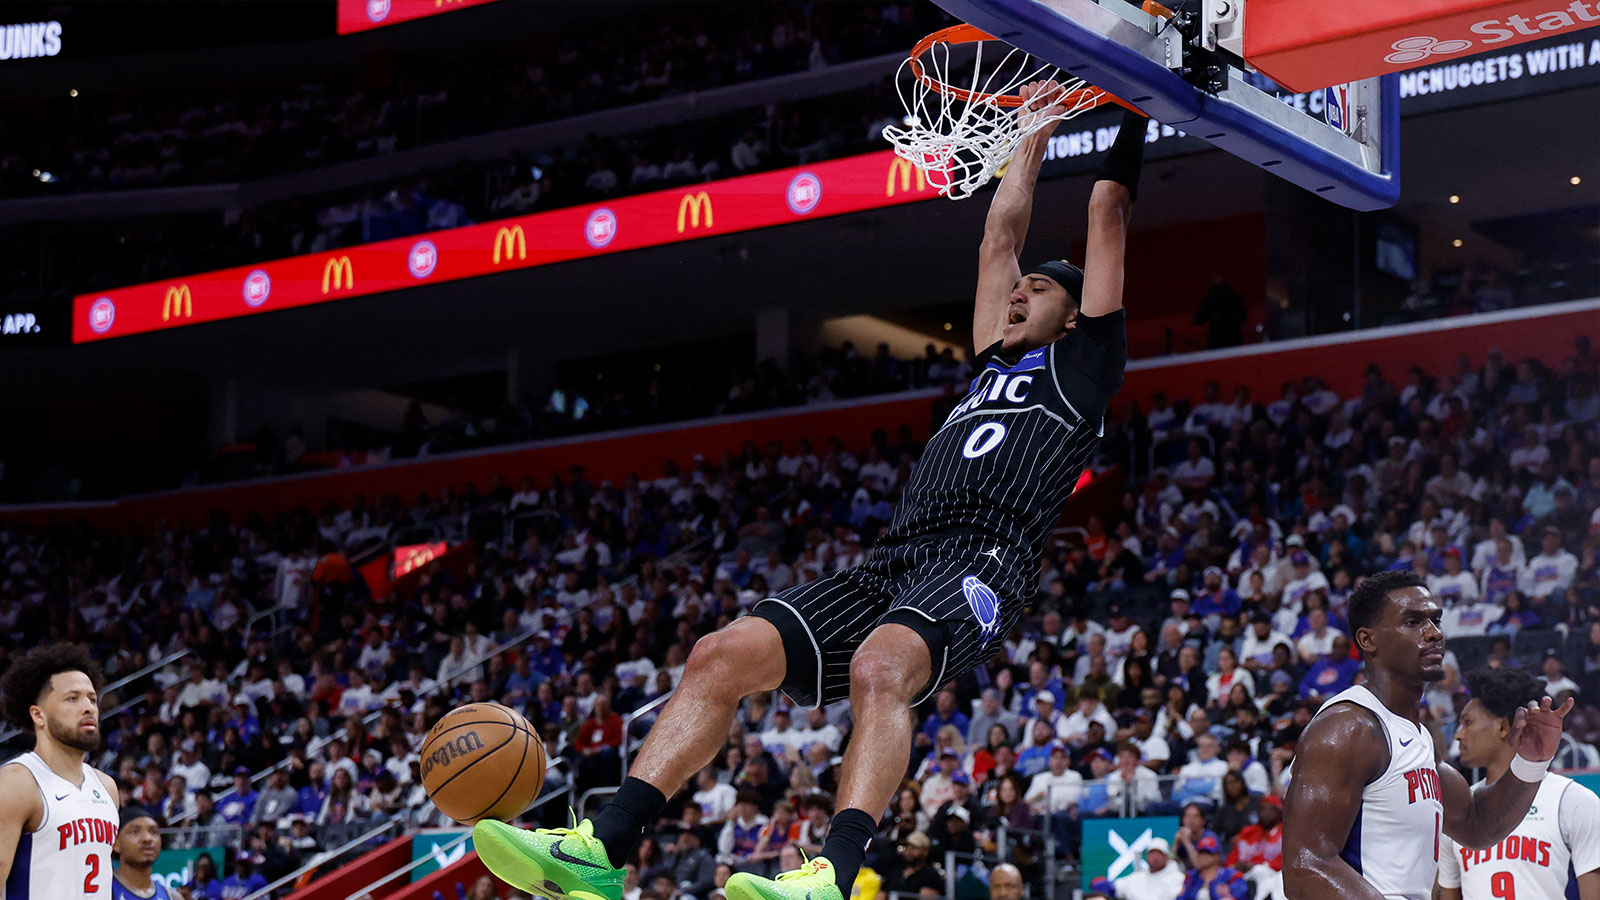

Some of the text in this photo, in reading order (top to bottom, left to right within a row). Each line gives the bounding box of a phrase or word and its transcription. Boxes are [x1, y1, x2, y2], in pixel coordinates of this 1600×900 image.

[1400, 53, 1524, 99] MCNUGGETS
[1525, 42, 1585, 76] WITH
[1042, 130, 1094, 161] TONS
[2, 312, 40, 335] APP.
[963, 421, 1007, 459] 0
[84, 853, 99, 893] 2
[1491, 871, 1515, 900] 9
